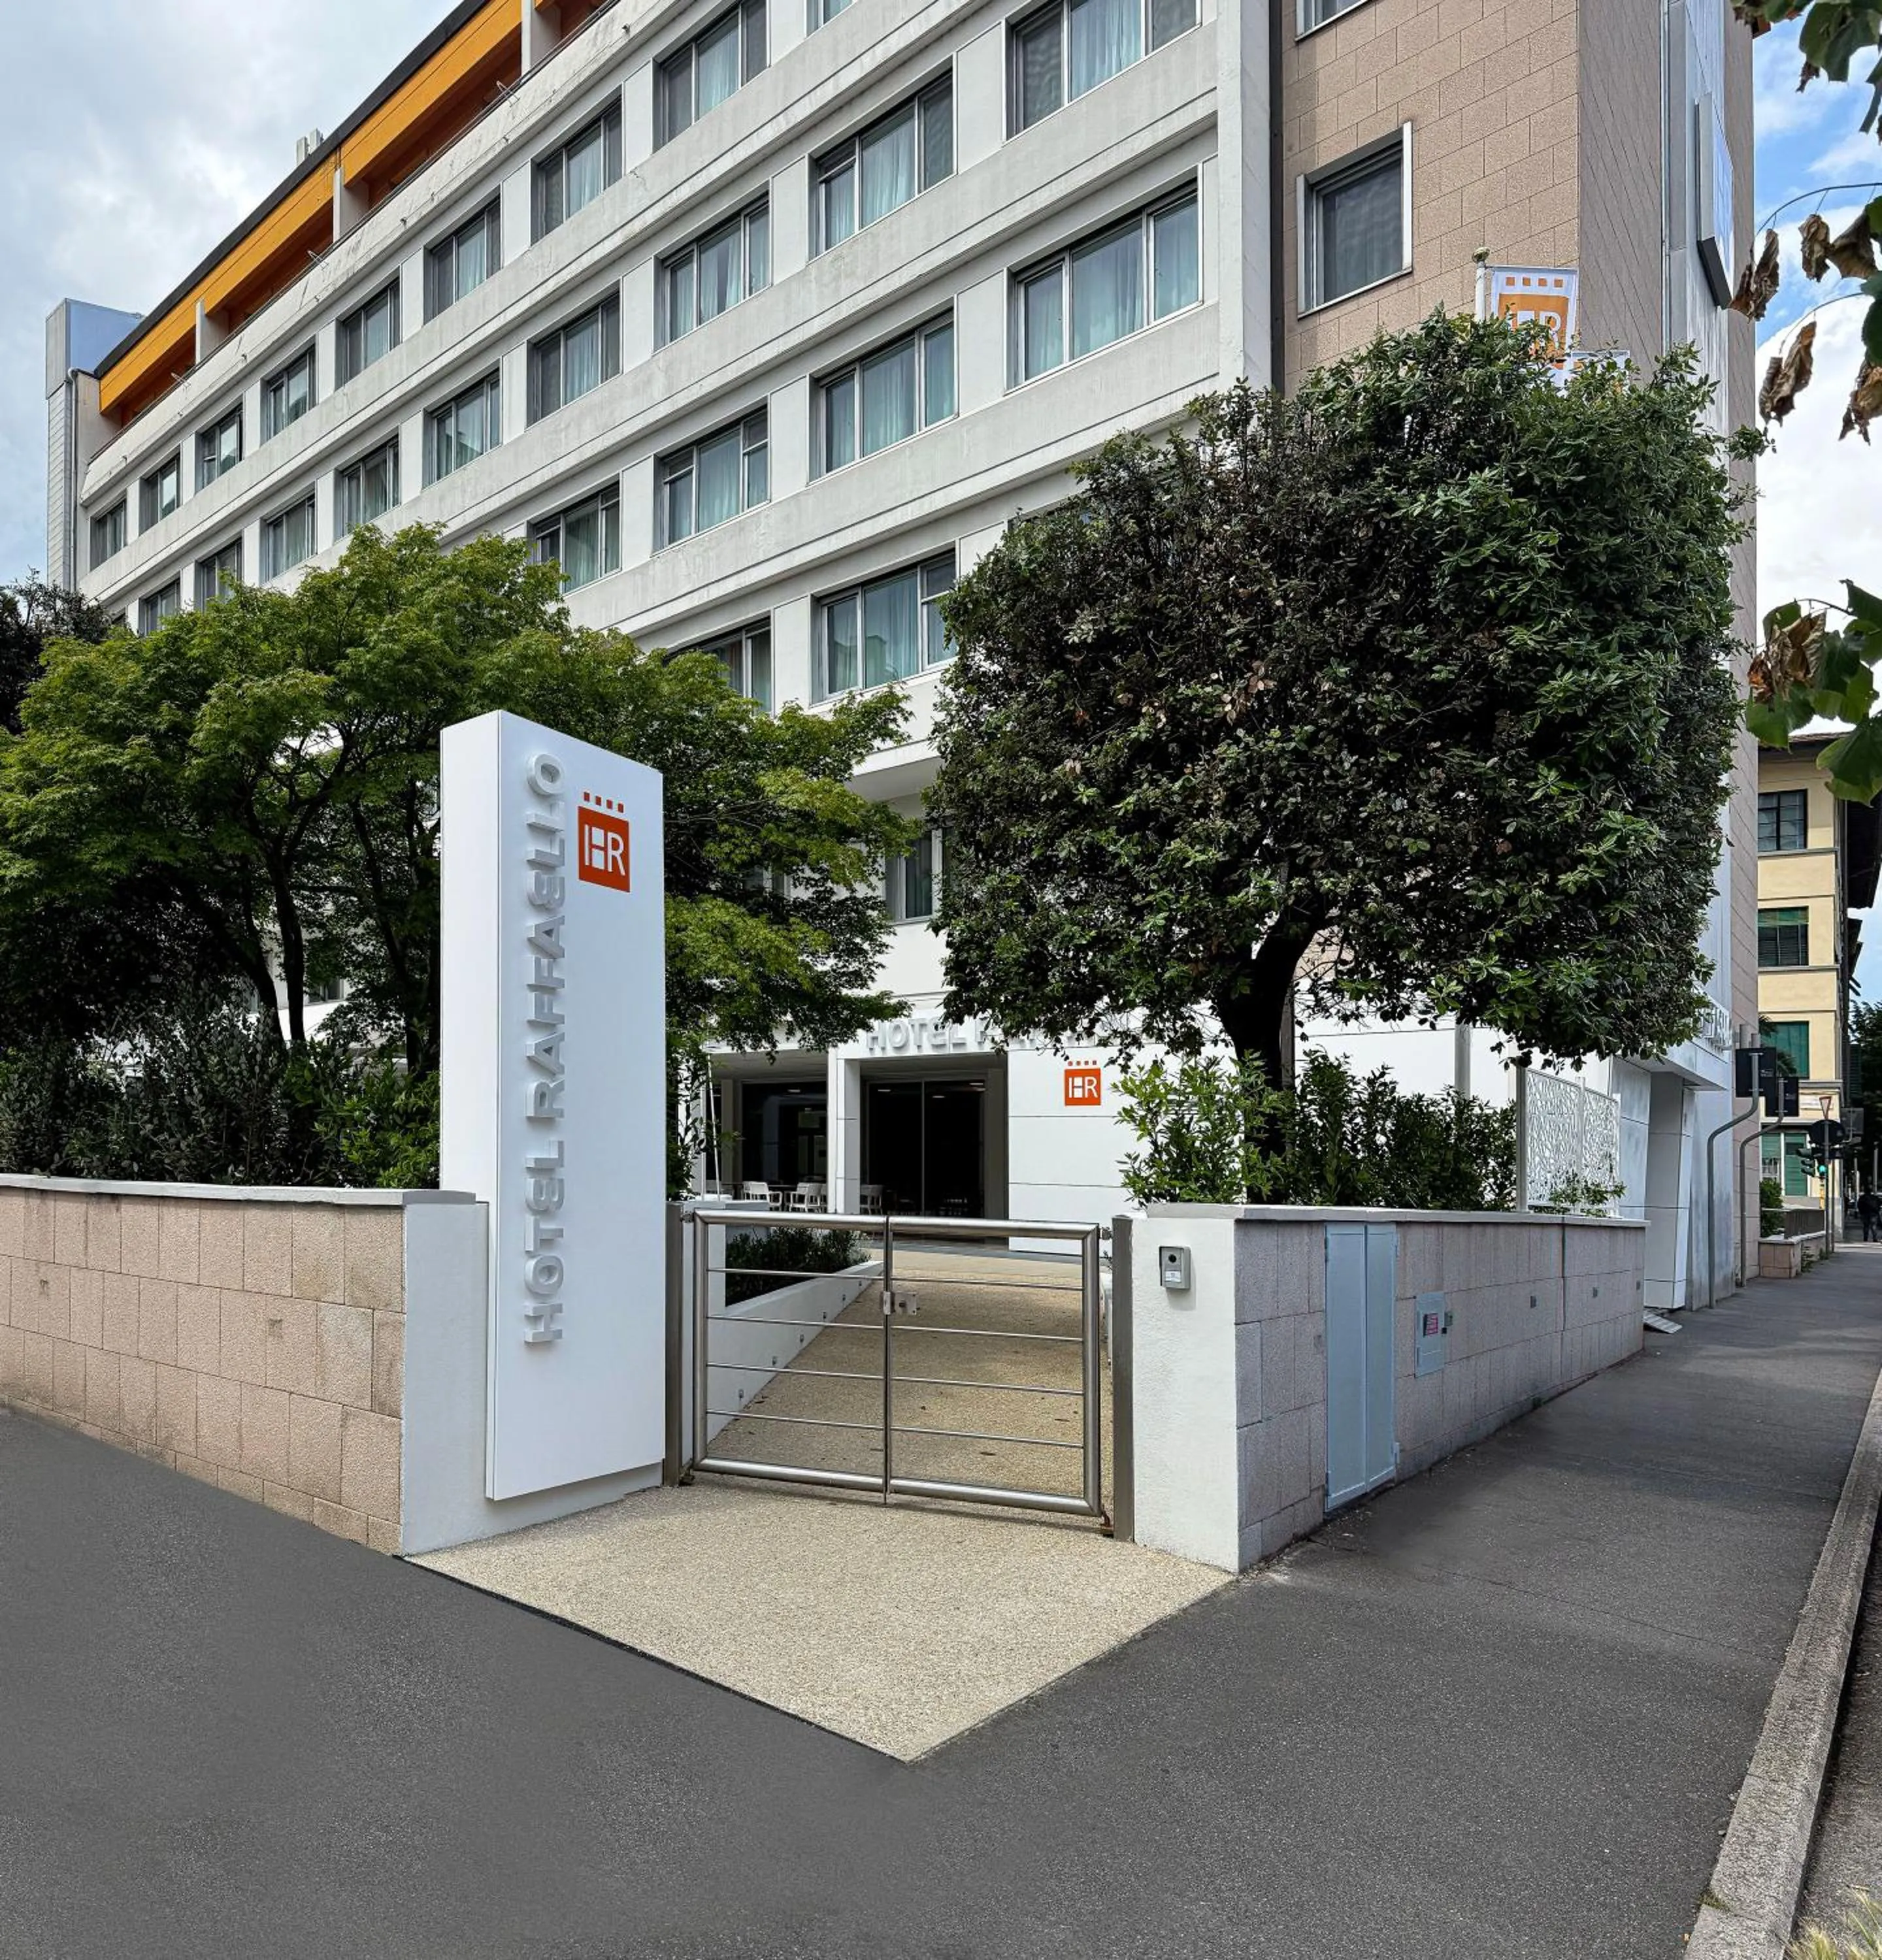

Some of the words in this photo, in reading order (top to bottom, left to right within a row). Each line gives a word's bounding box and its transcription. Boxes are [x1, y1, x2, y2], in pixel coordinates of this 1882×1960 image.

[584, 823, 626, 876] HR
[526, 753, 566, 1119] RAFFAELLO
[867, 1017, 967, 1051] HOTEL
[1068, 1076, 1098, 1098] HR
[525, 1140, 565, 1343] HOTEL
